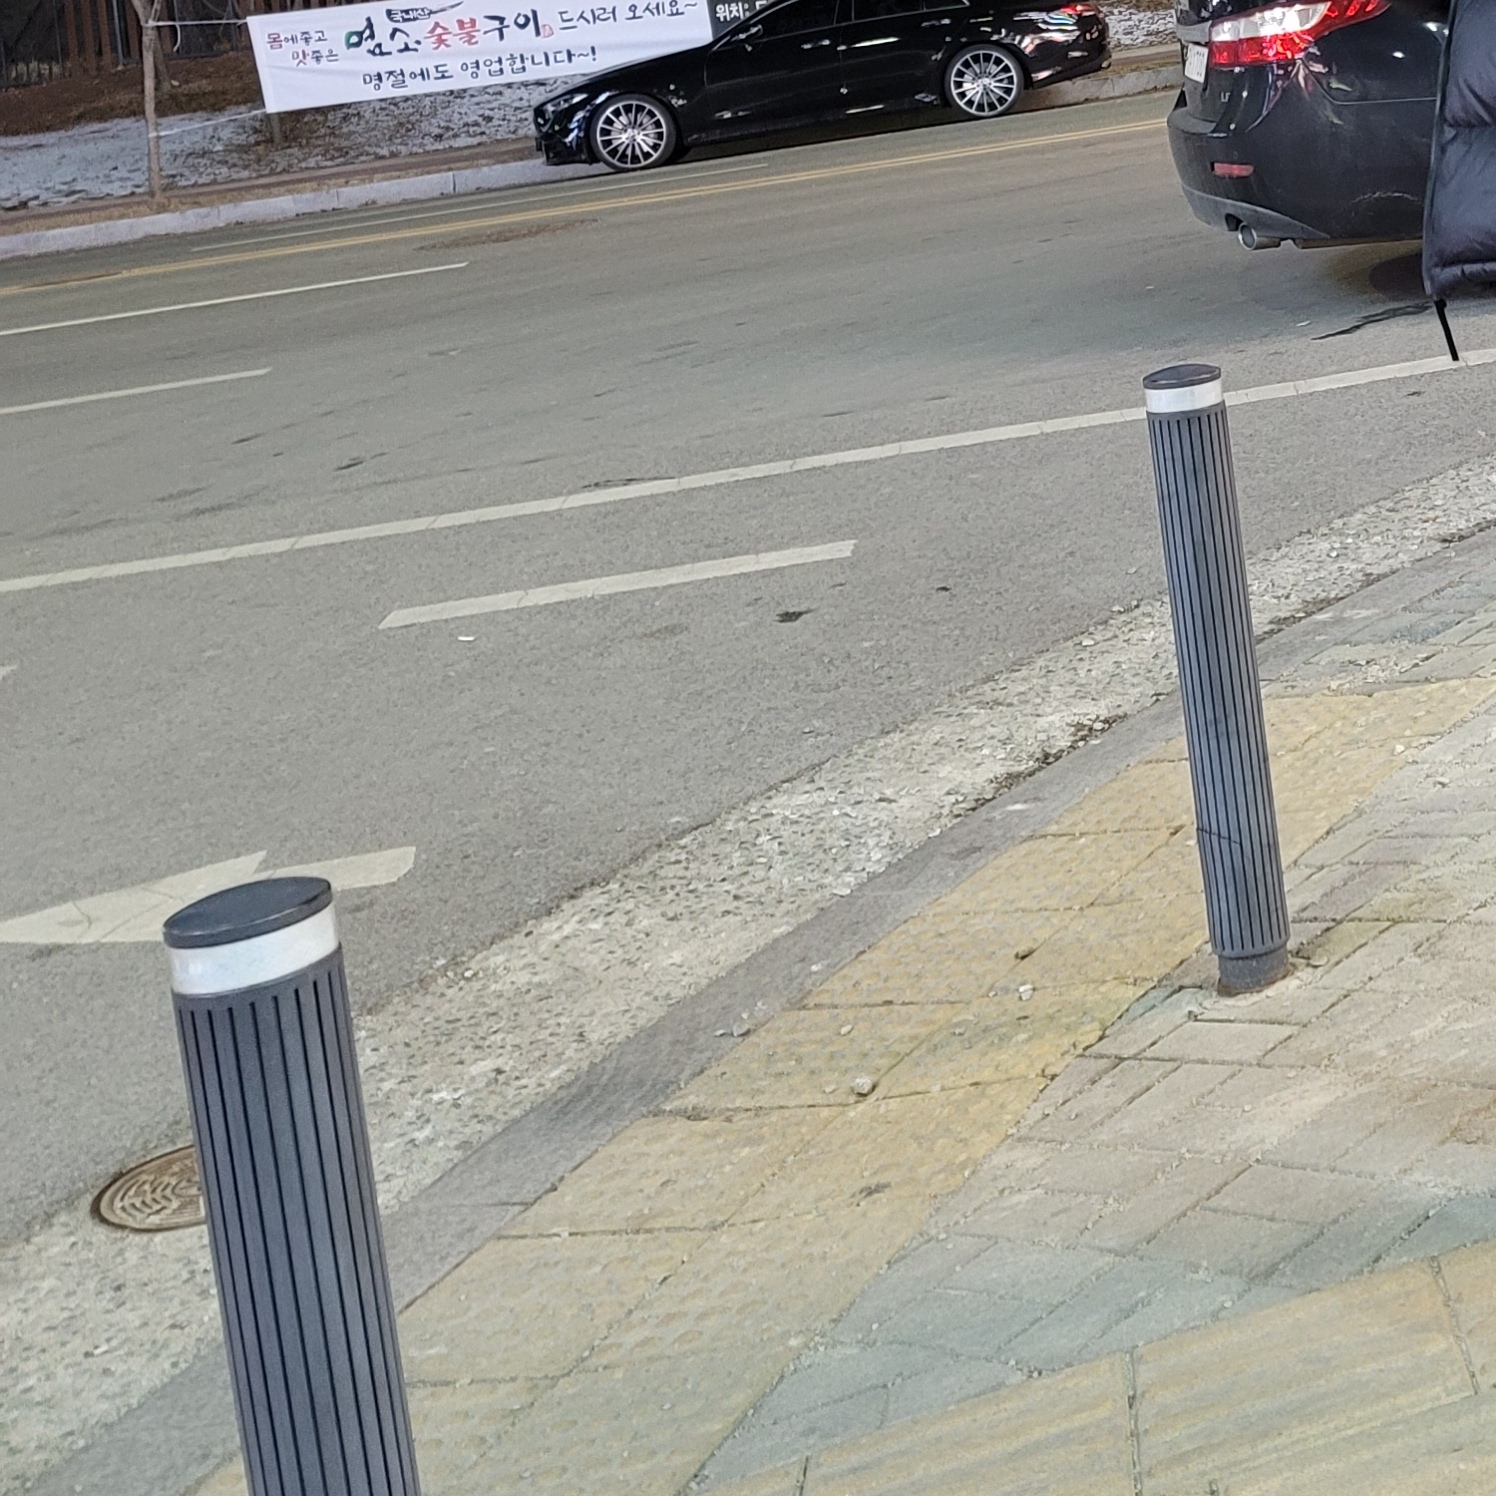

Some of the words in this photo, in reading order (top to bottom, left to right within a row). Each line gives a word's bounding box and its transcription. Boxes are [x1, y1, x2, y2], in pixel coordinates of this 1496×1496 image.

[558, 5, 618, 31] 드시러
[715, 2, 749, 22] 위치:
[266, 30, 329, 51] 몸에좋고
[291, 48, 340, 68] 맛좋은
[362, 63, 454, 92] 명절에도
[460, 45, 598, 80] 영업합니다~!
